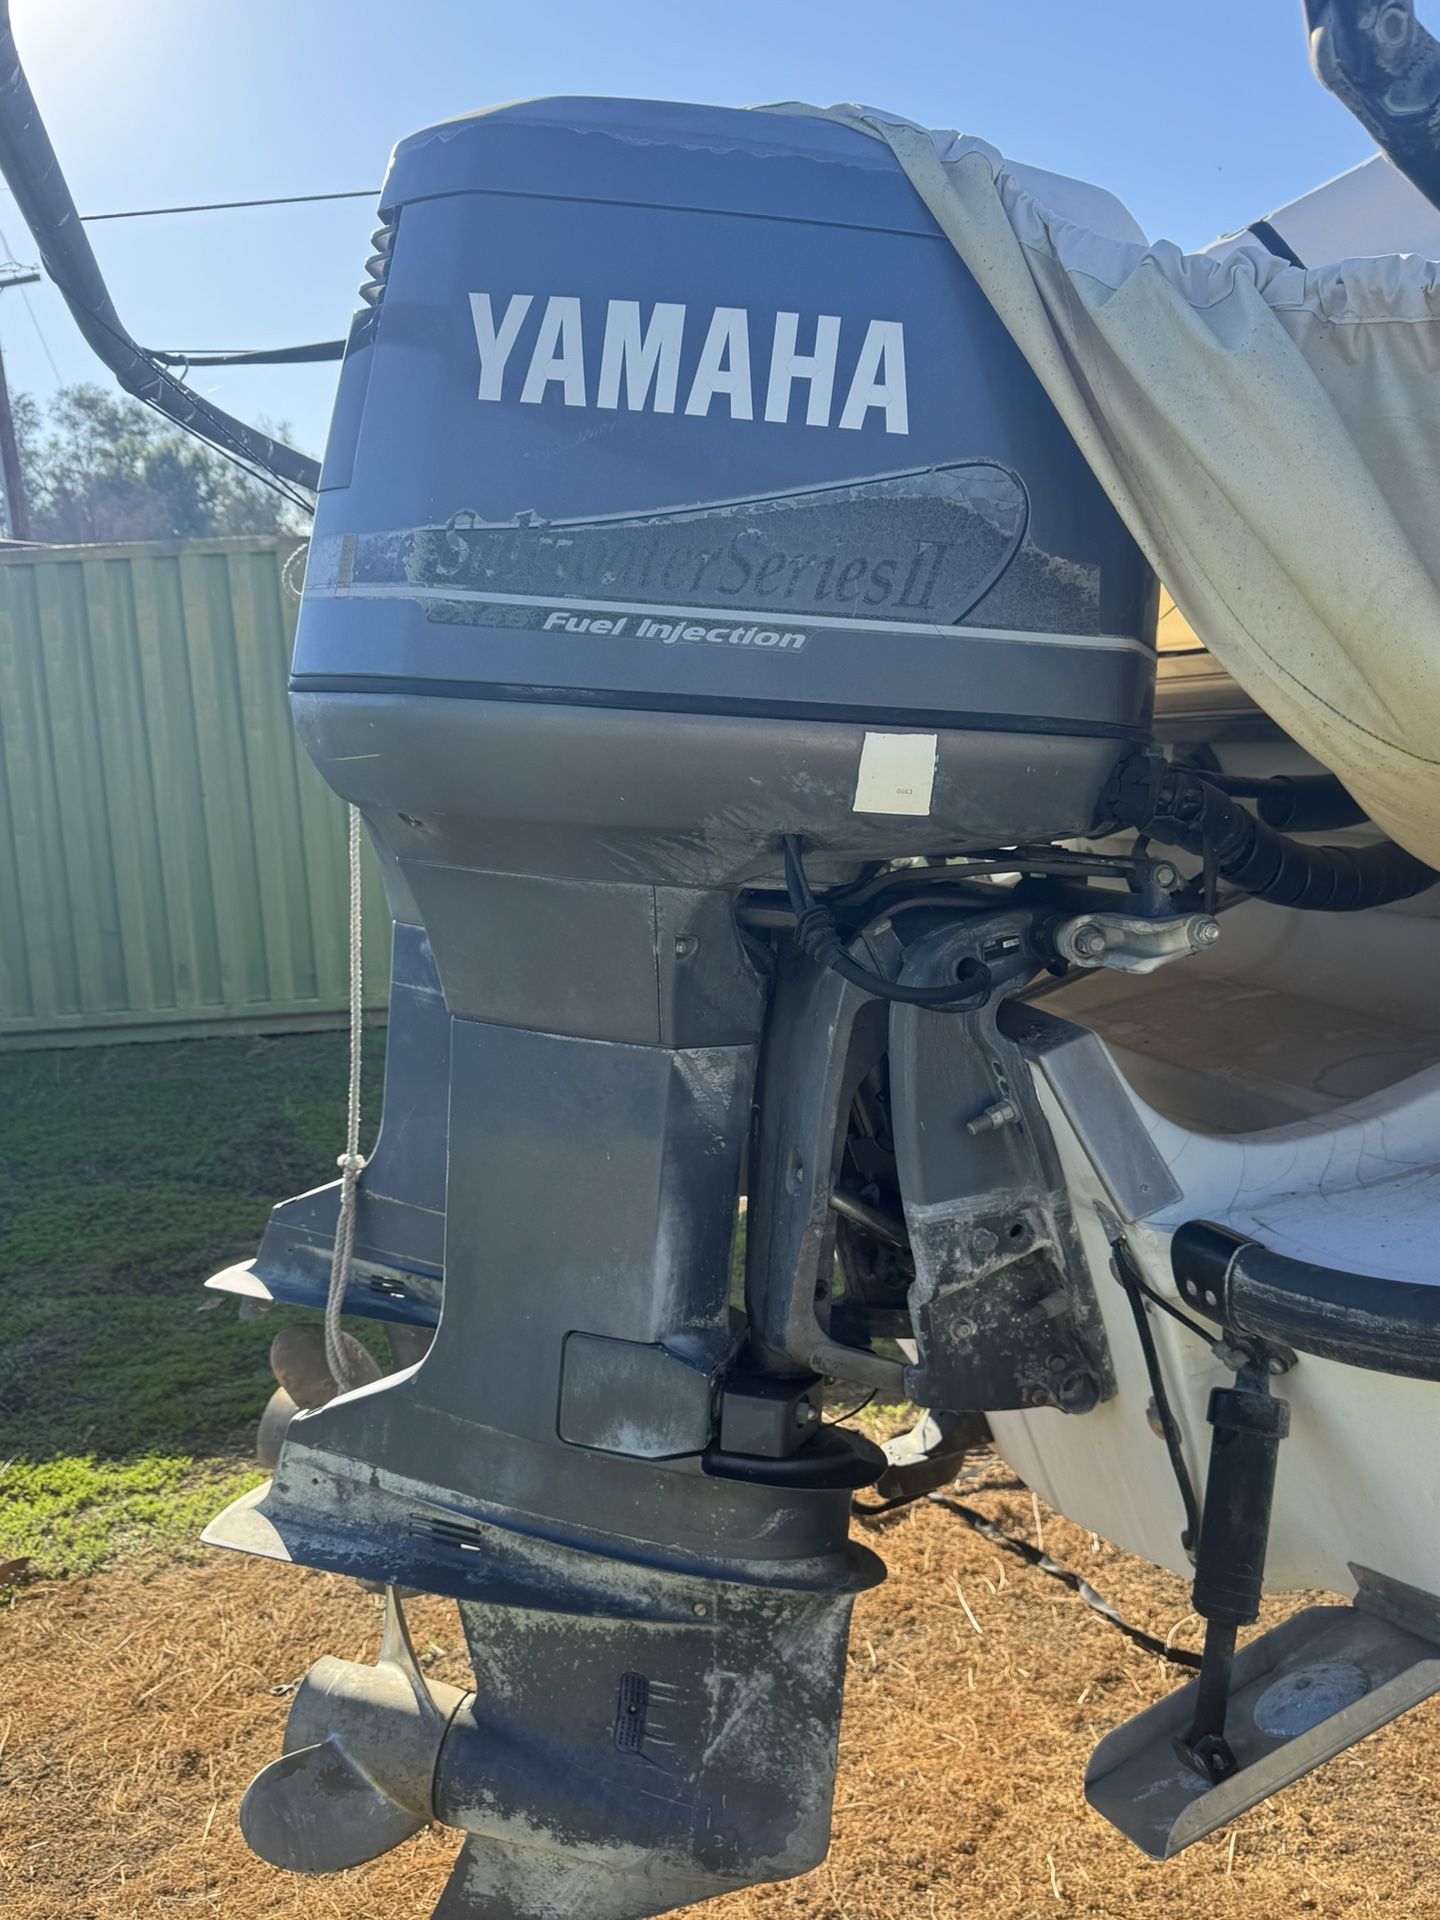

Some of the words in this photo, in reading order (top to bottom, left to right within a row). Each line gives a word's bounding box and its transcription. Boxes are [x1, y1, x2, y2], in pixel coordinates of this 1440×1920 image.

[469, 292, 909, 435] YAMAHA
[543, 611, 628, 636] Fuel
[635, 618, 807, 649] Injection
